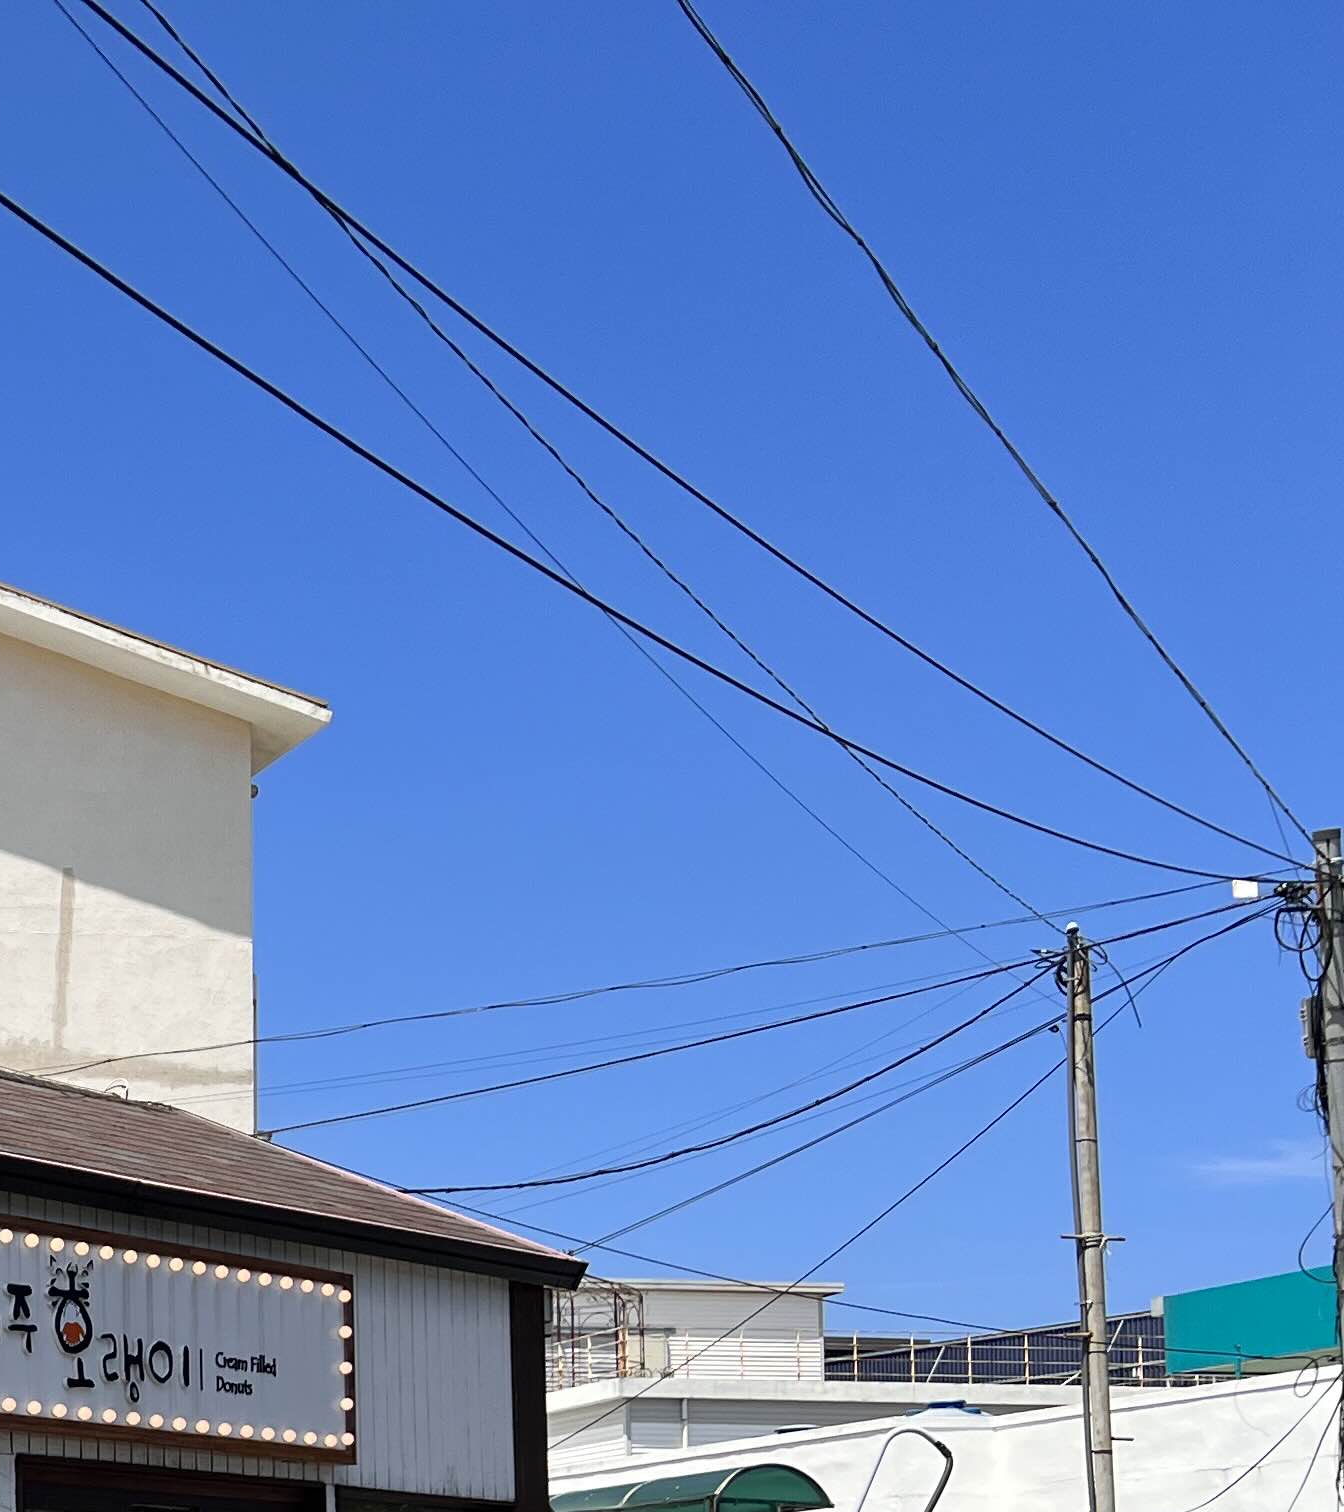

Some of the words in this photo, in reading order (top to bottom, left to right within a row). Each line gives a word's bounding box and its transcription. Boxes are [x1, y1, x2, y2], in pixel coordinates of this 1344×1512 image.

[214, 1351, 248, 1373] Cream
[249, 1355, 277, 1377] Filled
[215, 1376, 254, 1396] Donuts
